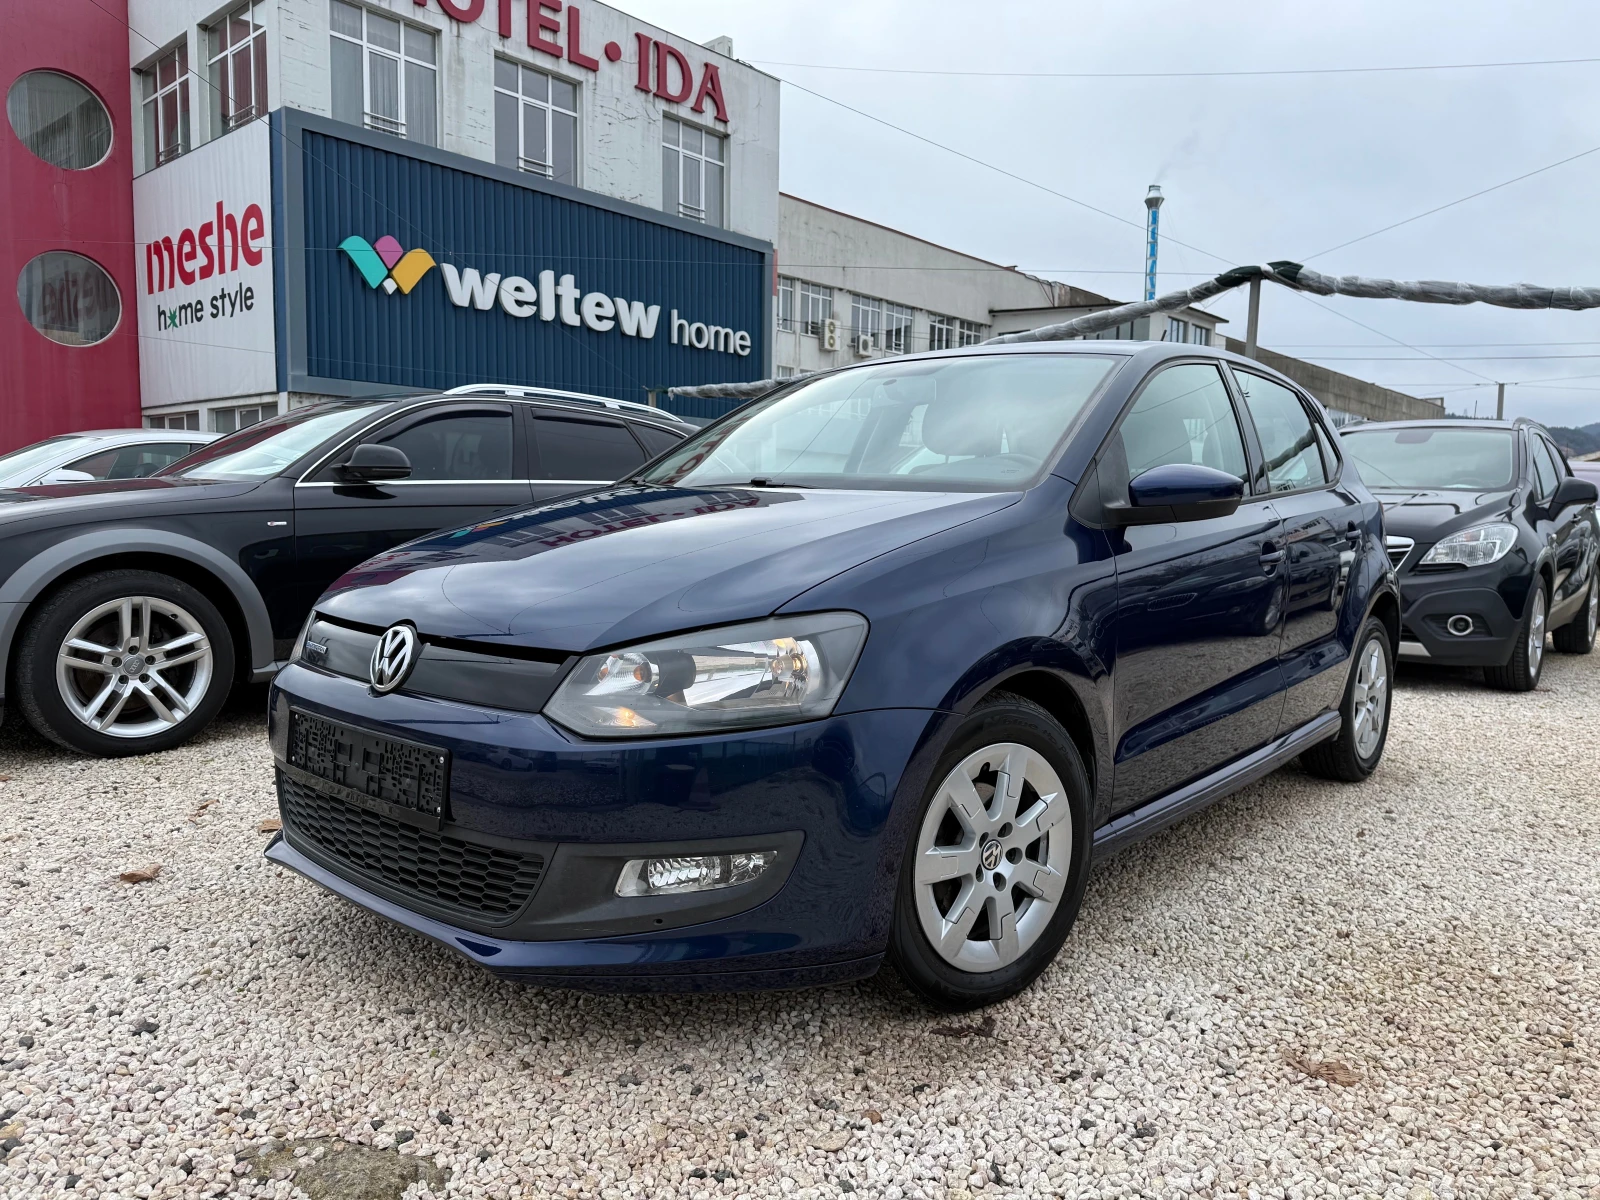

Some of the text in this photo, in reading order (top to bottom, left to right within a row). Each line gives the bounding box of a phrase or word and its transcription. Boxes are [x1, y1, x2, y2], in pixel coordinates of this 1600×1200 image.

[413, 0, 729, 122] TEL IDA
[146, 200, 264, 295] meshe
[157, 282, 254, 331] hme style
[440, 263, 751, 356] weltew home
